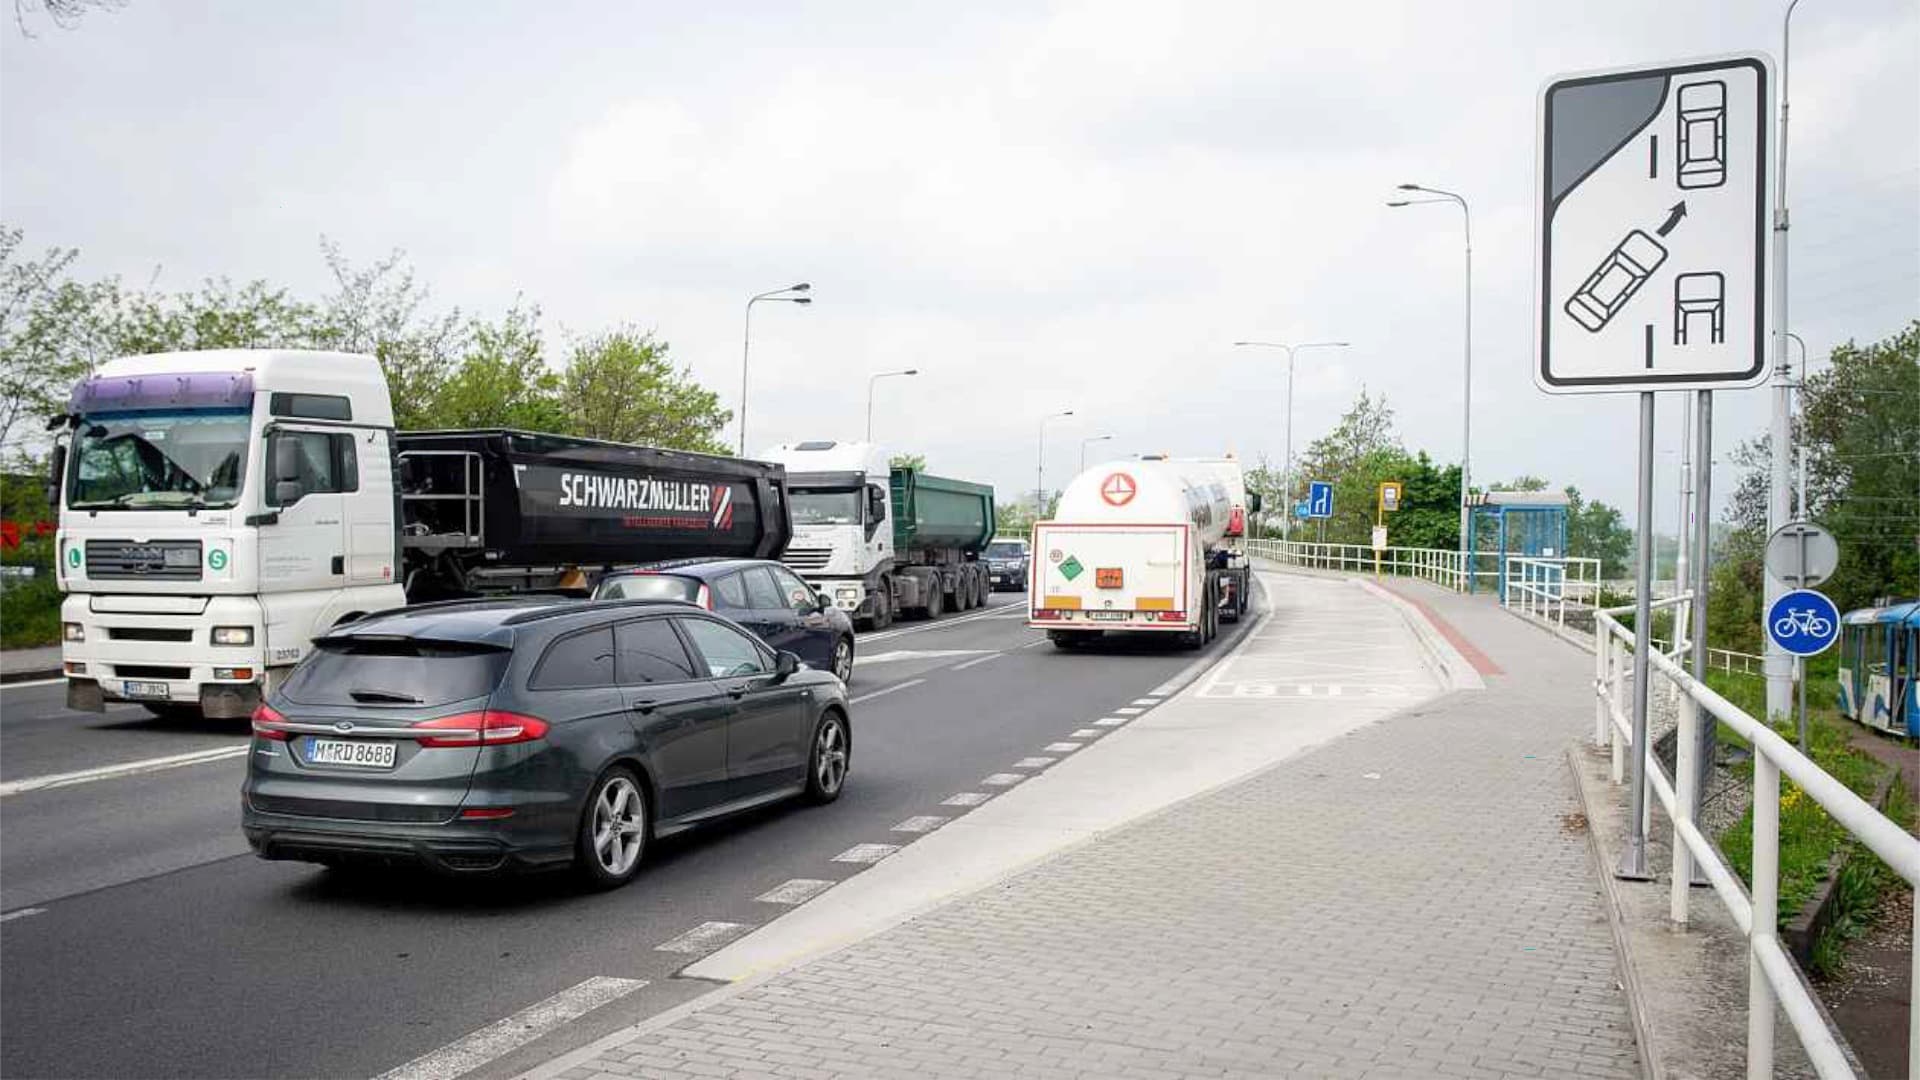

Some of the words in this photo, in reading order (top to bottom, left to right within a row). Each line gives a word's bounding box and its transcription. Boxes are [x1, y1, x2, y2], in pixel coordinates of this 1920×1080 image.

[559, 473, 710, 512] SCHWARZMÜLLER
[212, 551, 223, 569] S
[356, 745, 393, 764] 8688
